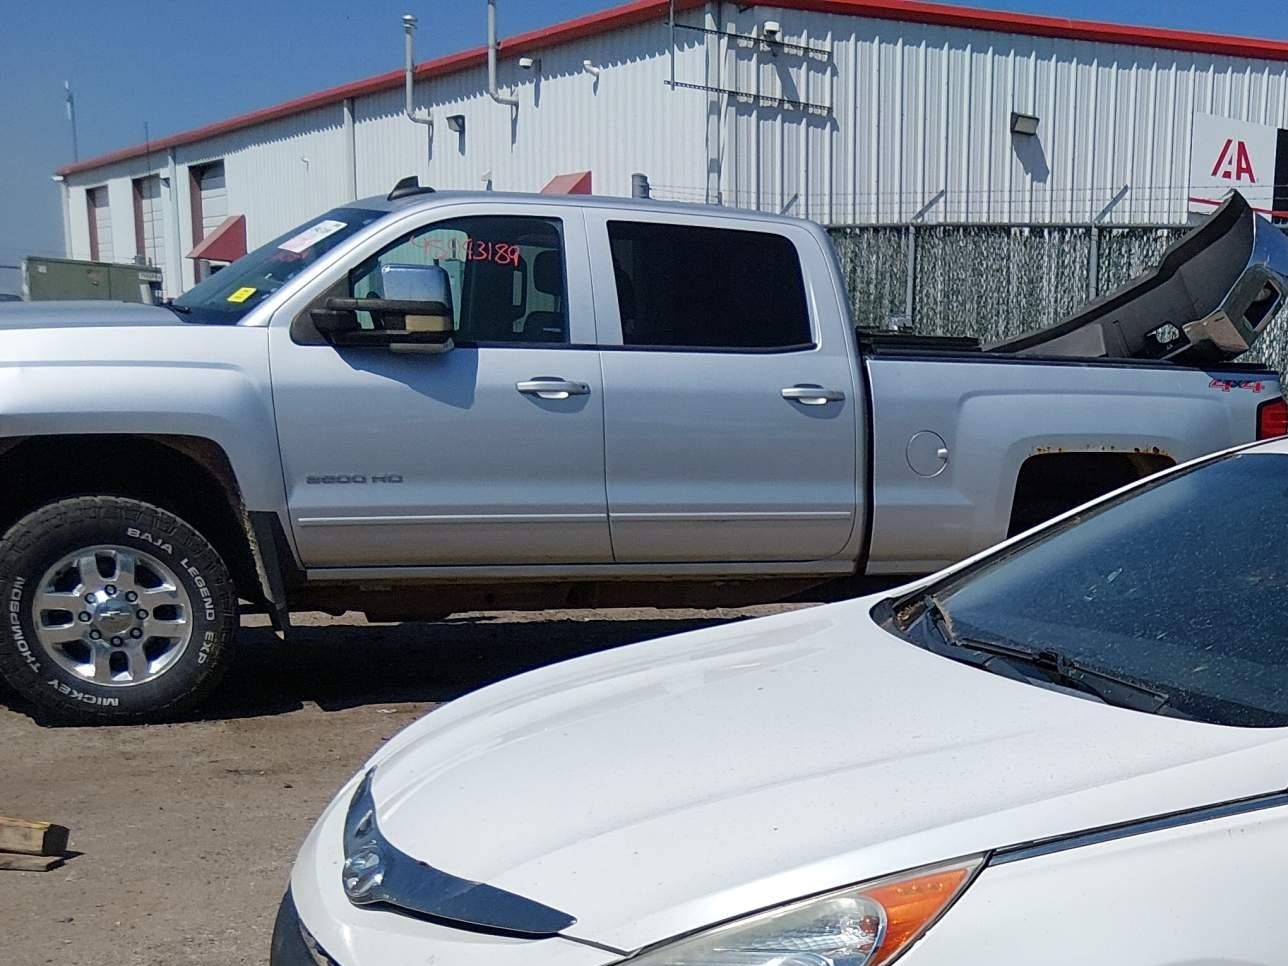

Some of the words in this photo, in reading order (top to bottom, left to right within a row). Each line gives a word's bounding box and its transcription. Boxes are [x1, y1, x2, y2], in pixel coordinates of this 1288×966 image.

[126, 527, 174, 554] BAJA
[179, 558, 216, 621] LEGEND
[9, 576, 43, 674] THOMPSON
[197, 631, 216, 665] EXP
[48, 678, 119, 707] MICKEY
